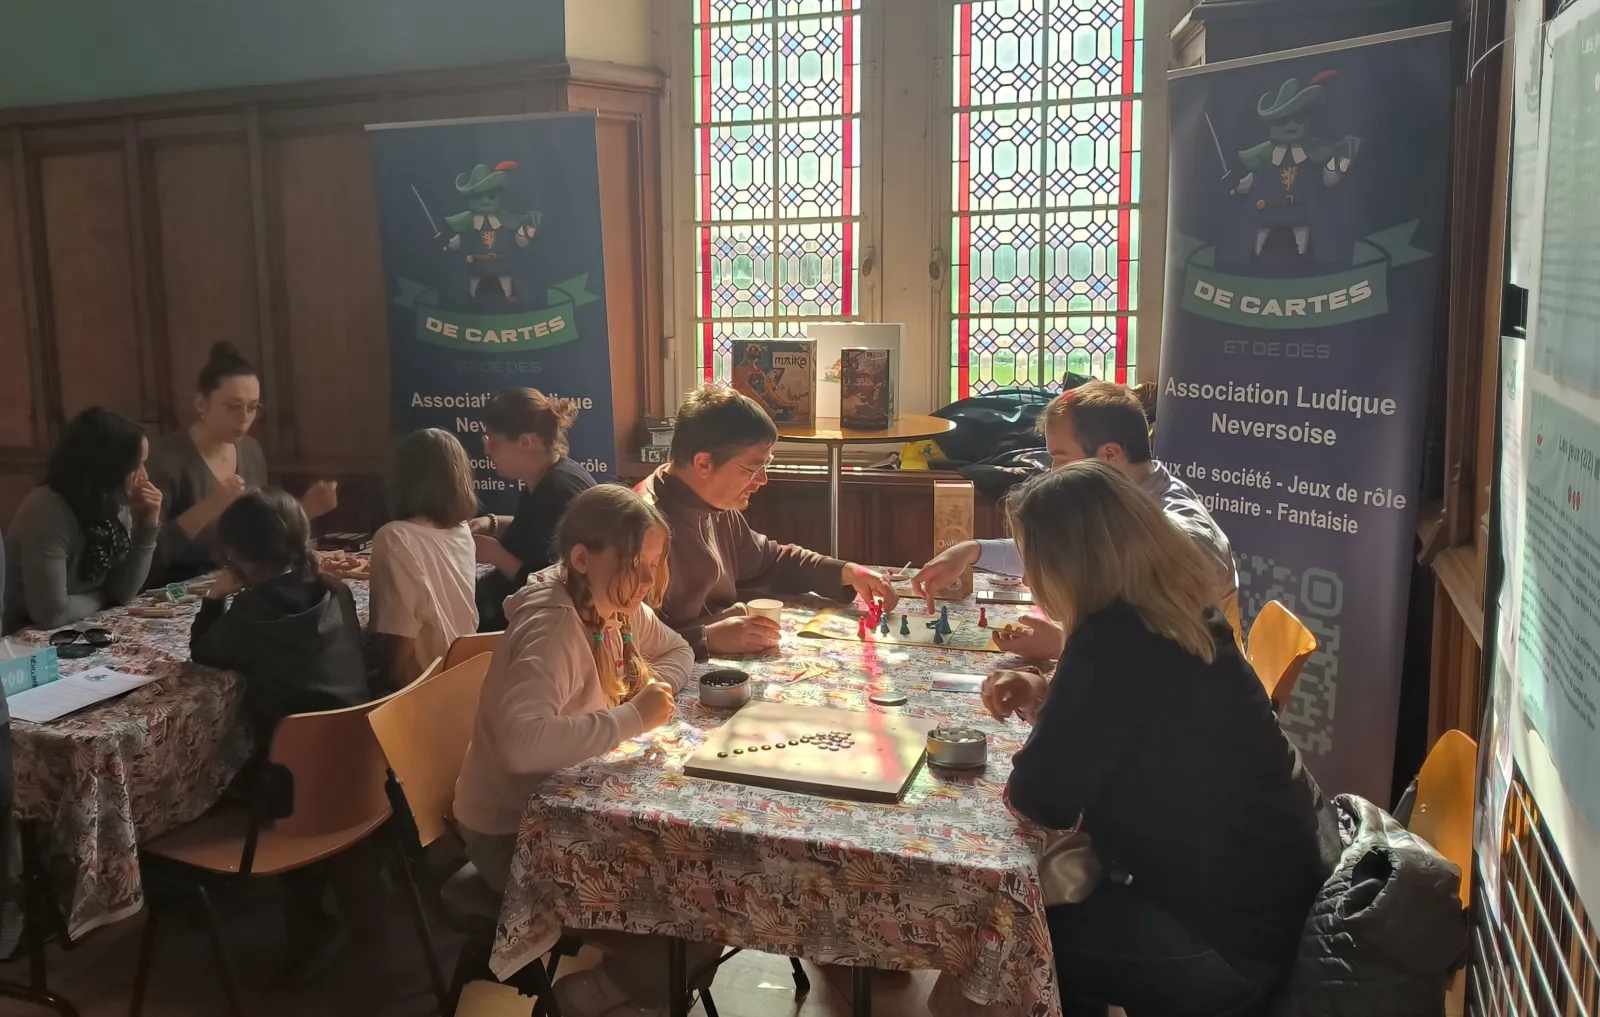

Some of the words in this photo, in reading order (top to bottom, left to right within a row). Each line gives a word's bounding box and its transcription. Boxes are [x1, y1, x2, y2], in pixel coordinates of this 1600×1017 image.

[1193, 280, 1235, 309] DE
[1240, 280, 1373, 317] CARTES
[425, 316, 459, 339] DE
[465, 315, 566, 343] CARTES
[1223, 340, 1250, 354] ET
[1252, 342, 1281, 357] DE
[456, 361, 478, 374] ET
[480, 361, 503, 374] DE
[411, 392, 491, 408] Associat
[1164, 376, 1289, 407] Association
[1296, 386, 1397, 419] Ludique
[1211, 412, 1337, 446] Neversoise
[1186, 461, 1206, 480] de
[1211, 467, 1272, 490] société
[1287, 475, 1331, 499] Jeux
[1335, 482, 1358, 503] de
[1363, 487, 1407, 510] rôle
[1277, 502, 1359, 534] Fantaisie
